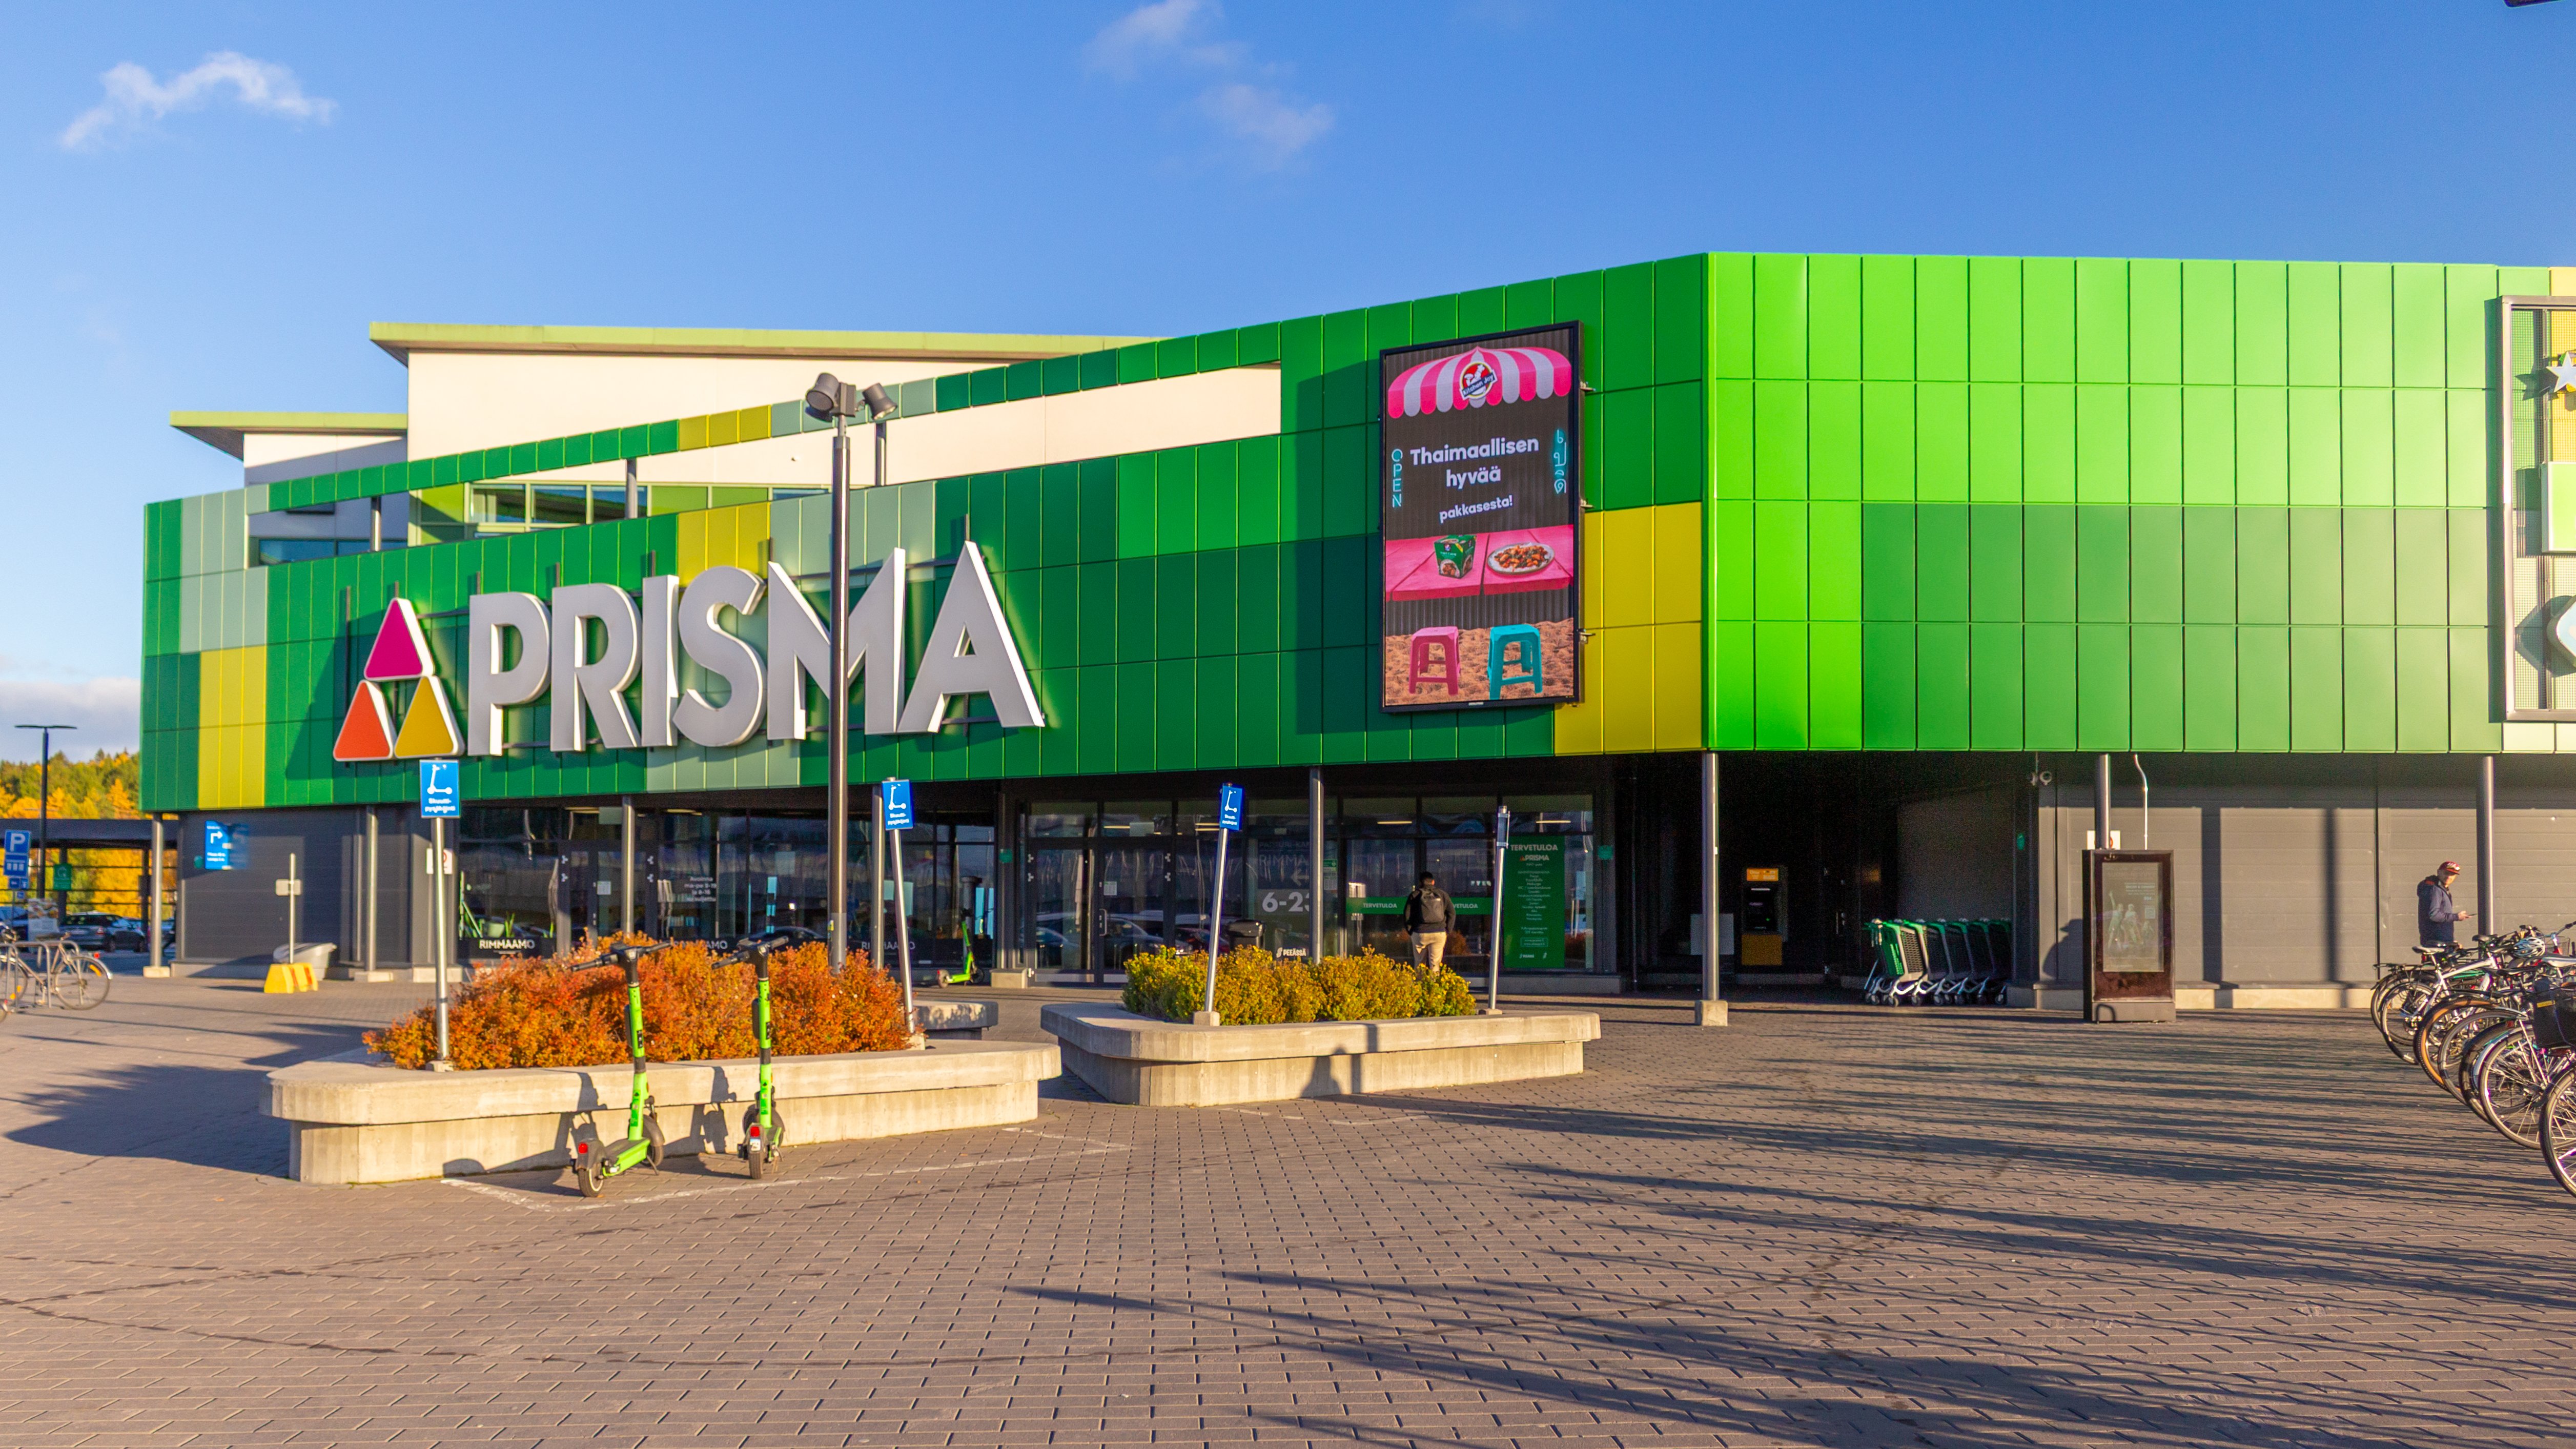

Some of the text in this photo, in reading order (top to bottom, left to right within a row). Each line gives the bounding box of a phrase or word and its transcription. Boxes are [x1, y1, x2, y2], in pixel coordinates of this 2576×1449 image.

[1462, 381, 1484, 395] Kitchen
[1410, 437, 1539, 466] Thaimaallisen
[1391, 448, 1403, 508] OPEN
[1446, 465, 1501, 489] hyvää
[1439, 495, 1513, 524] pakkasesta!
[468, 540, 1046, 756] PRISMA
[10, 833, 26, 851] P
[1259, 854, 1310, 866] RIMMA
[479, 939, 535, 949] RIMMAAMO
[1283, 948, 1306, 956] PEEÄSSÄ
